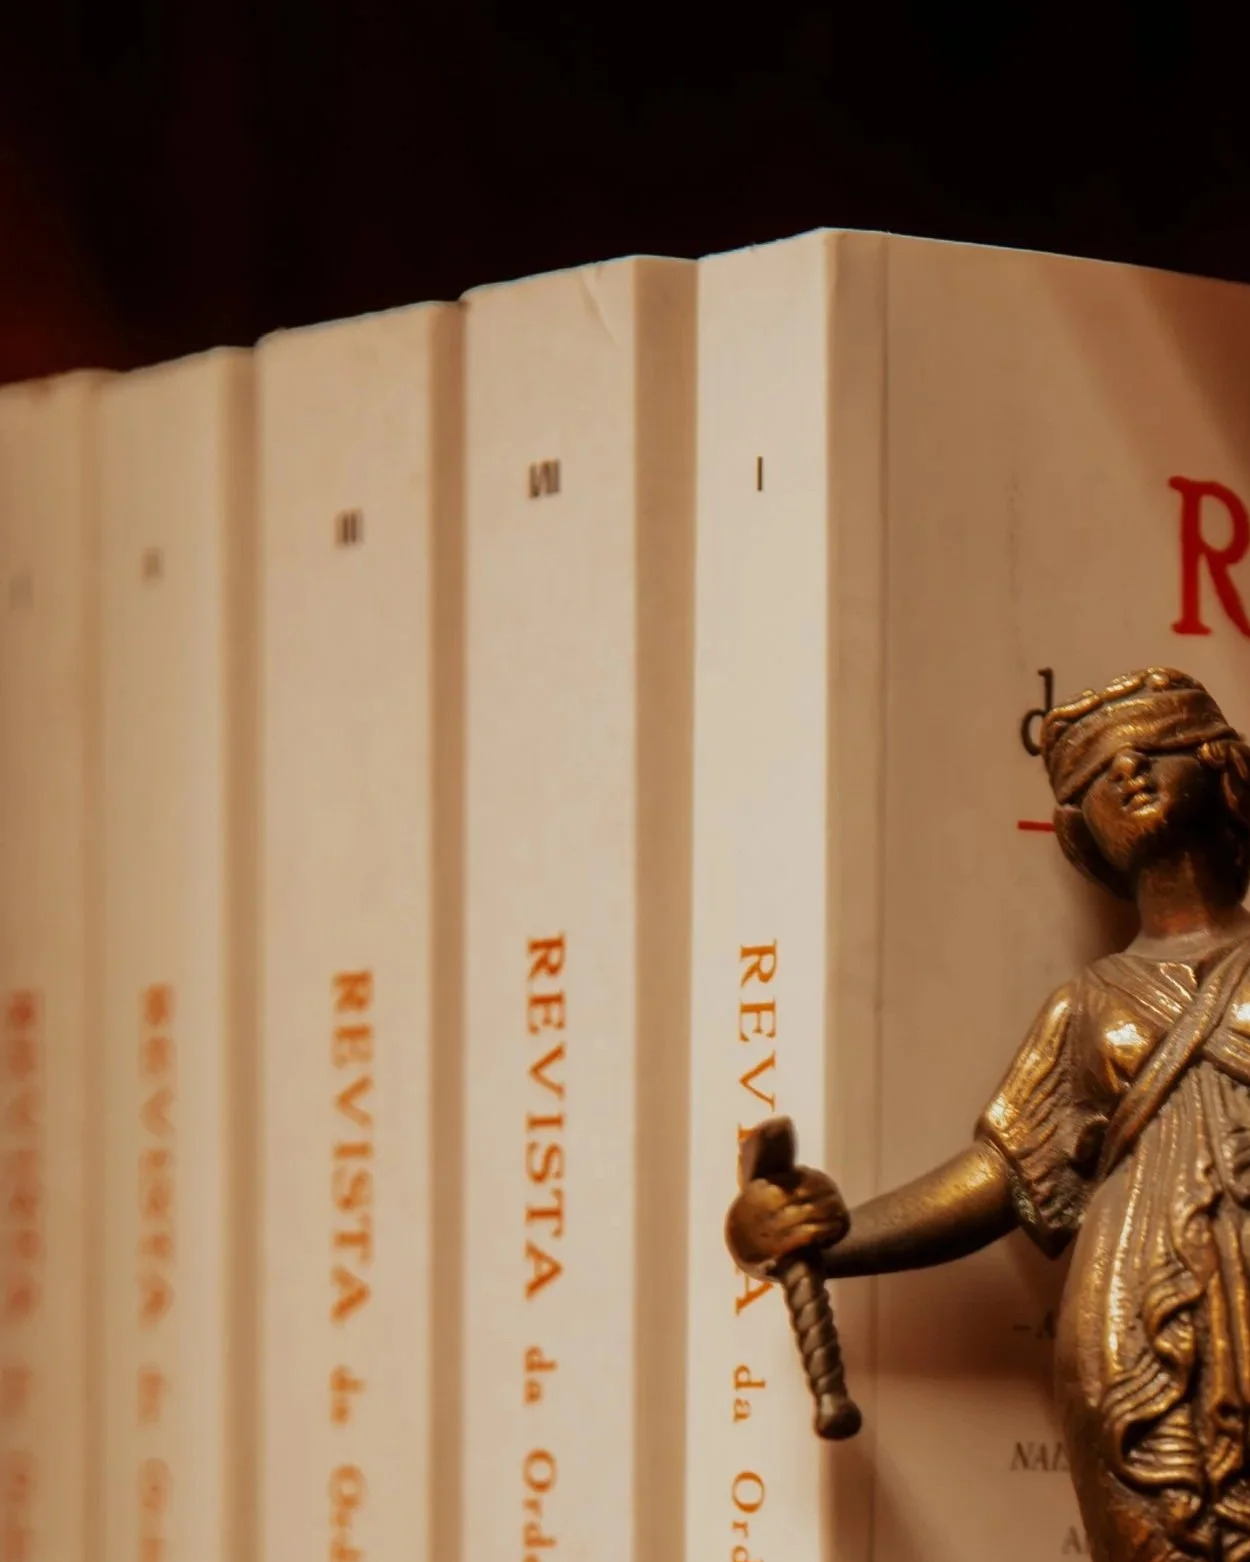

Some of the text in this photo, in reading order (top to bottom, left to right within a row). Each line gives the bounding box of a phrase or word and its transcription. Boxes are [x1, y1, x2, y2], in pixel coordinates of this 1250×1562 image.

[331, 968, 373, 1328] REVISTA
[523, 930, 567, 1302] REVISTA
[734, 938, 779, 1317] REVA
[522, 1343, 558, 1406] da
[732, 1363, 767, 1424] da
